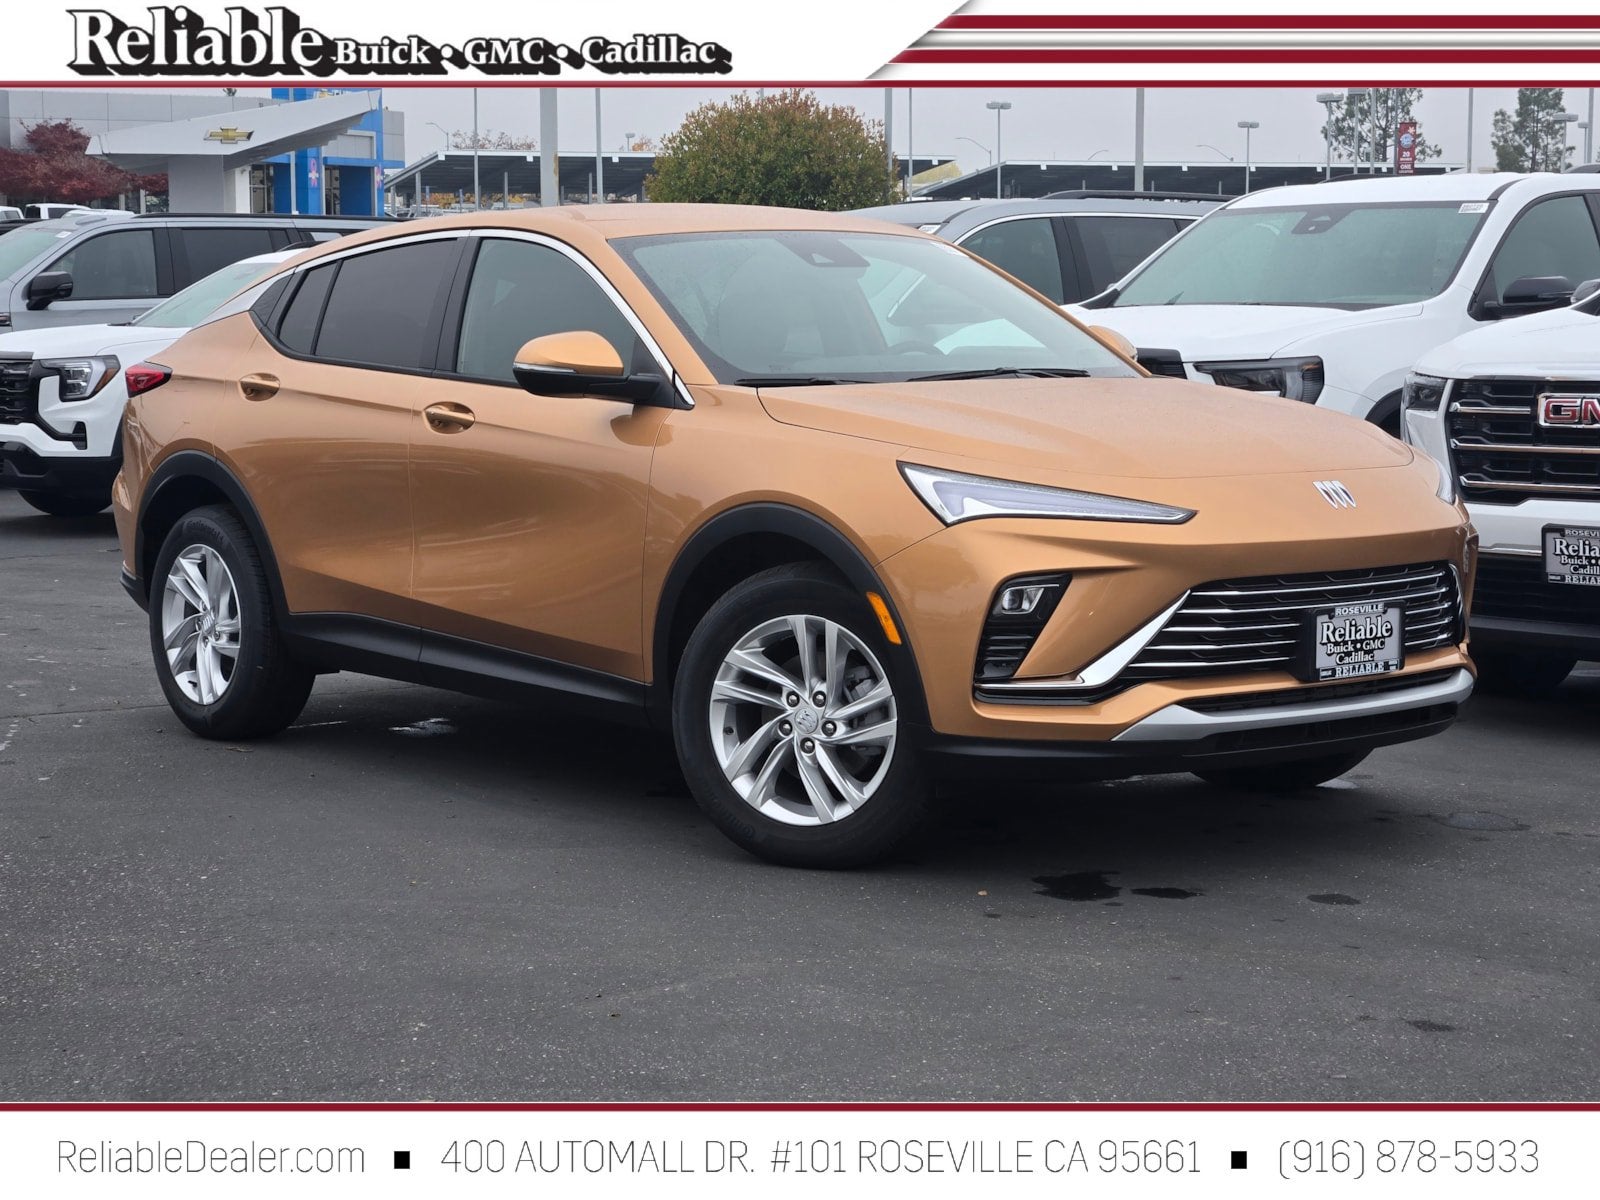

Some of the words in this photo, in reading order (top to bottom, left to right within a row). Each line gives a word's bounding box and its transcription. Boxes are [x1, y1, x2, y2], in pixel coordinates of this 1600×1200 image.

[1561, 555, 1589, 565] Buick
[1335, 604, 1383, 615] ROSEVILLE
[1321, 615, 1393, 643] Reliable
[1327, 641, 1354, 654] Buick
[1362, 638, 1385, 651] GMC
[1335, 650, 1374, 665] Cadillac
[1335, 661, 1384, 677] RELIABLE
